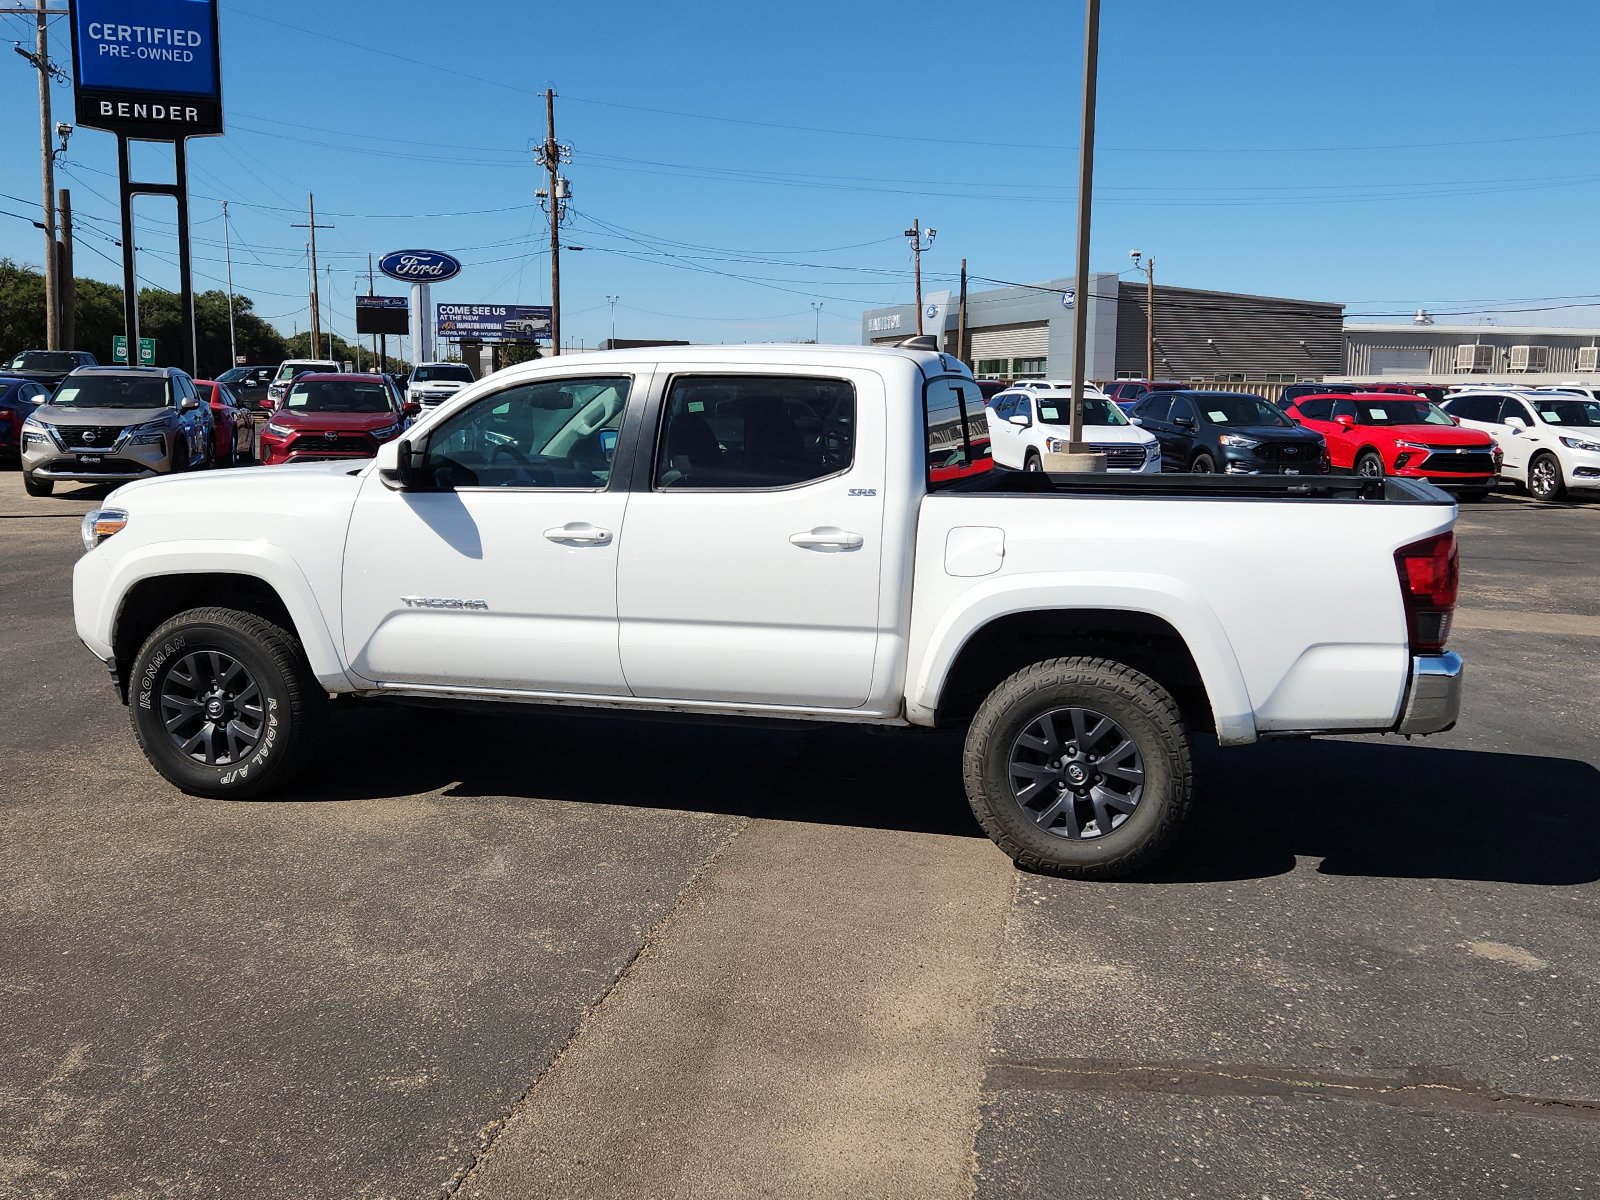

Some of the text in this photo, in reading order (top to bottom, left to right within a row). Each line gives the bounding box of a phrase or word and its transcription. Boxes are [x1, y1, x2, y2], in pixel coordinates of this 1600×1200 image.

[88, 22, 202, 47] CERTIFIED
[99, 43, 193, 63] PRE-OWNED
[100, 101, 198, 122] BENDER
[395, 254, 444, 275] Ford
[439, 305, 471, 315] COME
[472, 306, 491, 315] SEE
[492, 307, 507, 316] US
[847, 488, 877, 497] SR5
[399, 595, 489, 611] TACOMA
[139, 636, 186, 710] IRONMAN
[219, 697, 278, 785] RADIAL A/P
